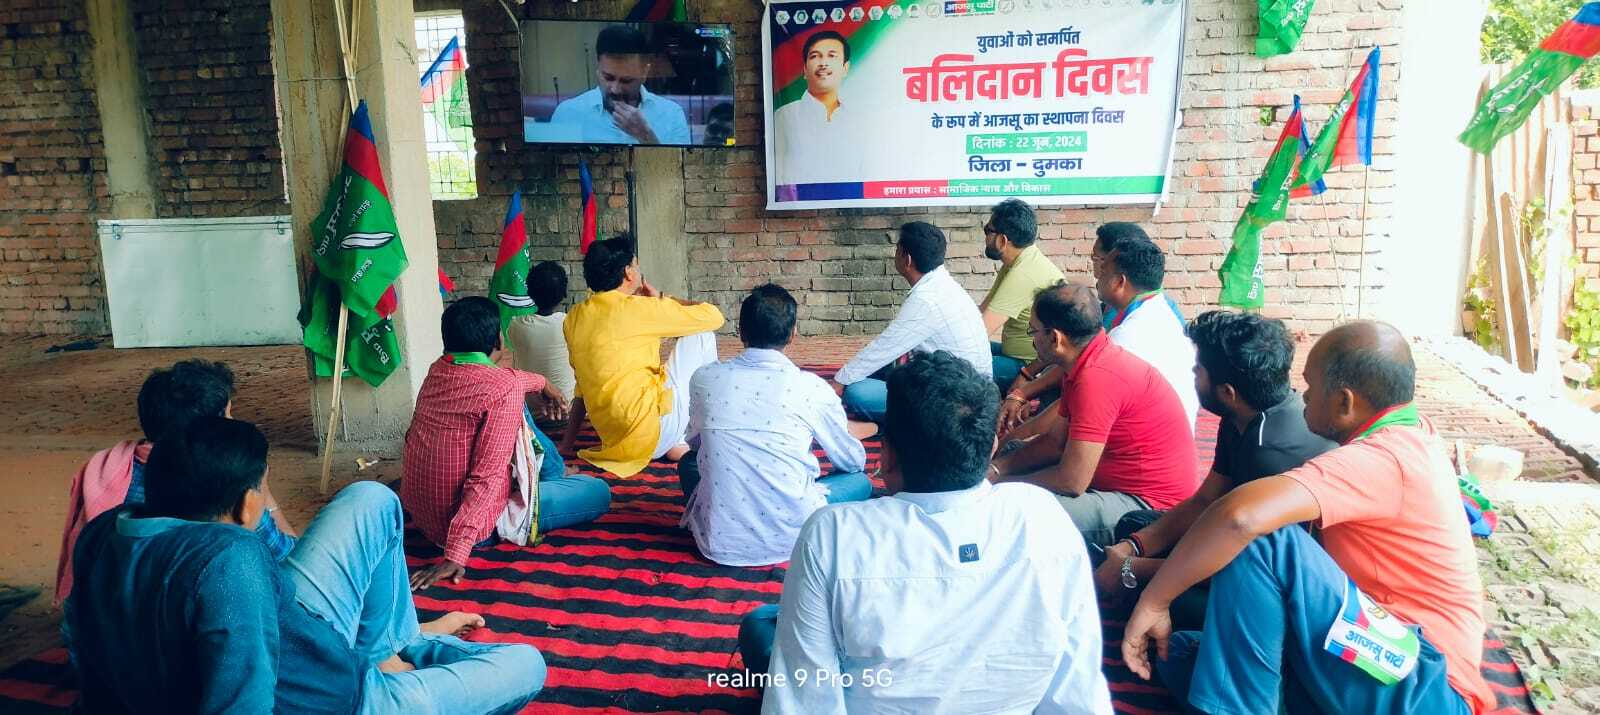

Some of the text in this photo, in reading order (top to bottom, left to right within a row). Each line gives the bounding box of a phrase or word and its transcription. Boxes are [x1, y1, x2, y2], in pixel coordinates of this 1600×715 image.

[977, 25, 1082, 53] युवाओं को समर्पित
[903, 48, 1154, 102] बलिदान दिवस
[931, 112, 943, 129] के
[968, 112, 982, 128] में
[984, 112, 1023, 131] आजसू
[1024, 112, 1039, 127] का
[1042, 110, 1089, 125] स्थापना
[1092, 107, 1126, 124] दिवस
[972, 135, 1007, 150] दिनांक
[1016, 137, 1030, 148] 22
[1055, 136, 1082, 147] 2024
[968, 155, 1012, 173] जिला
[1032, 157, 1083, 177] दुमका
[1345, 630, 1406, 670] आजसू पार्टी
